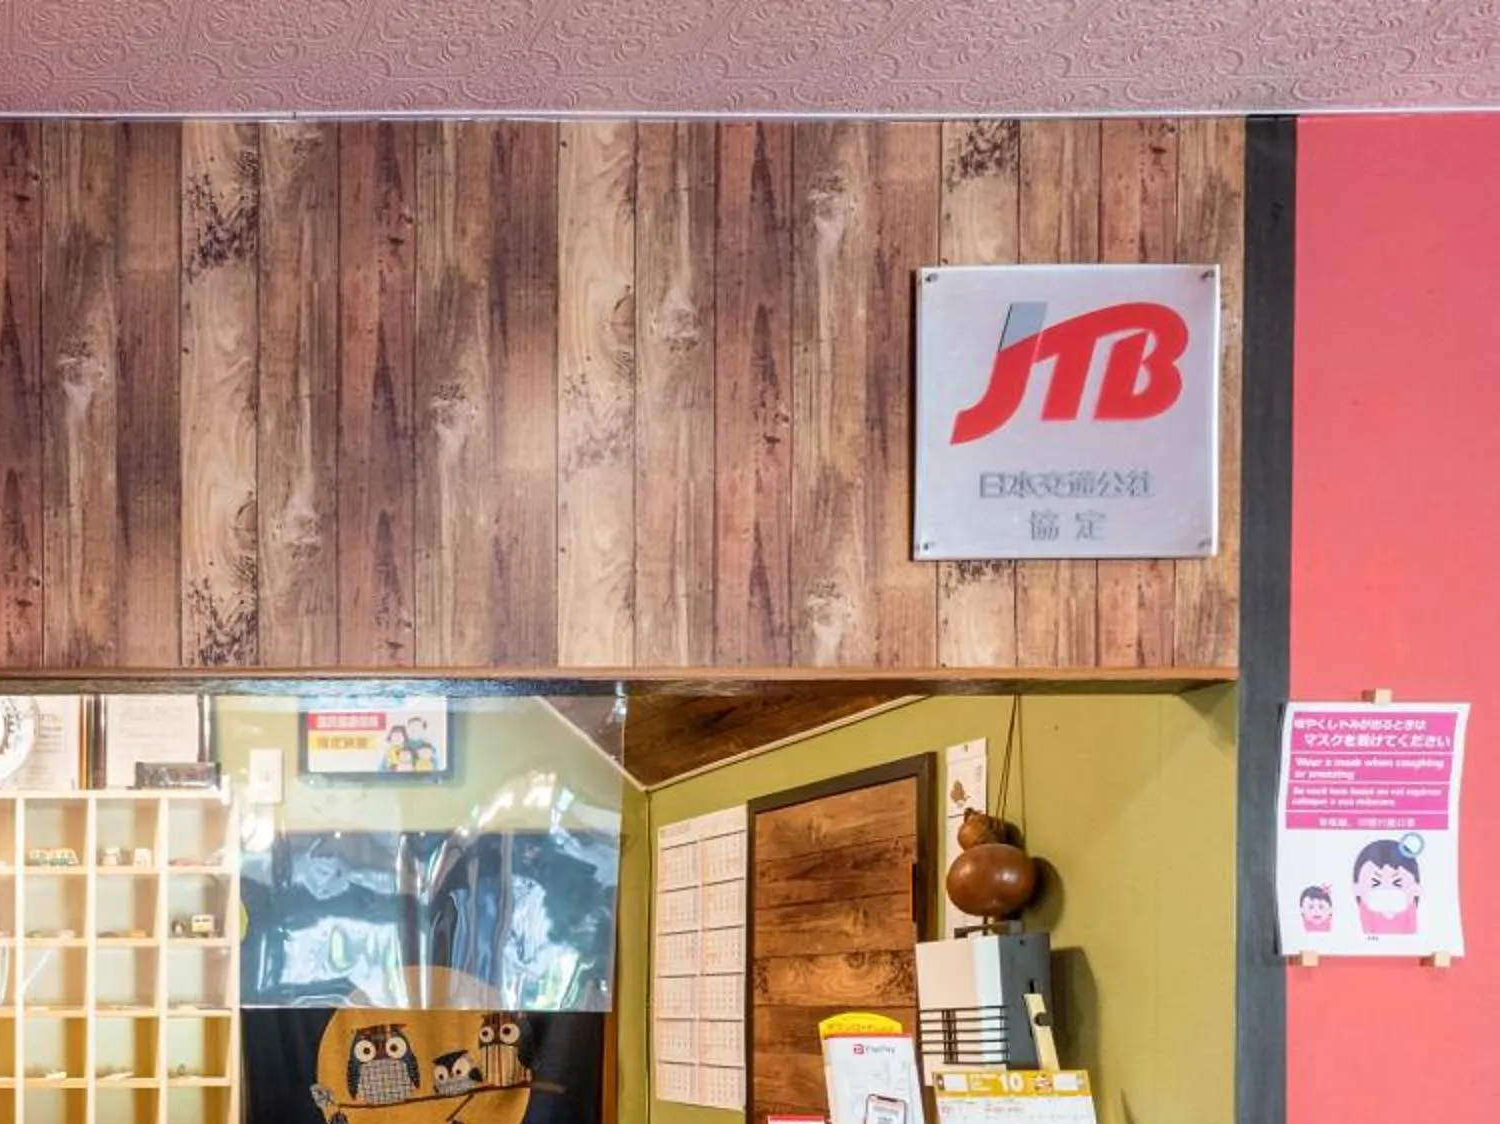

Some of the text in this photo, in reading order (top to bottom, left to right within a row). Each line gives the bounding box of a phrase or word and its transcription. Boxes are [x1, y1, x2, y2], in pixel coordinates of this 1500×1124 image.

[950, 302, 1189, 445] JTB
[978, 470, 1155, 498] 日本交通公社
[1364, 758, 1392, 767] when
[999, 1072, 1024, 1092] 10
